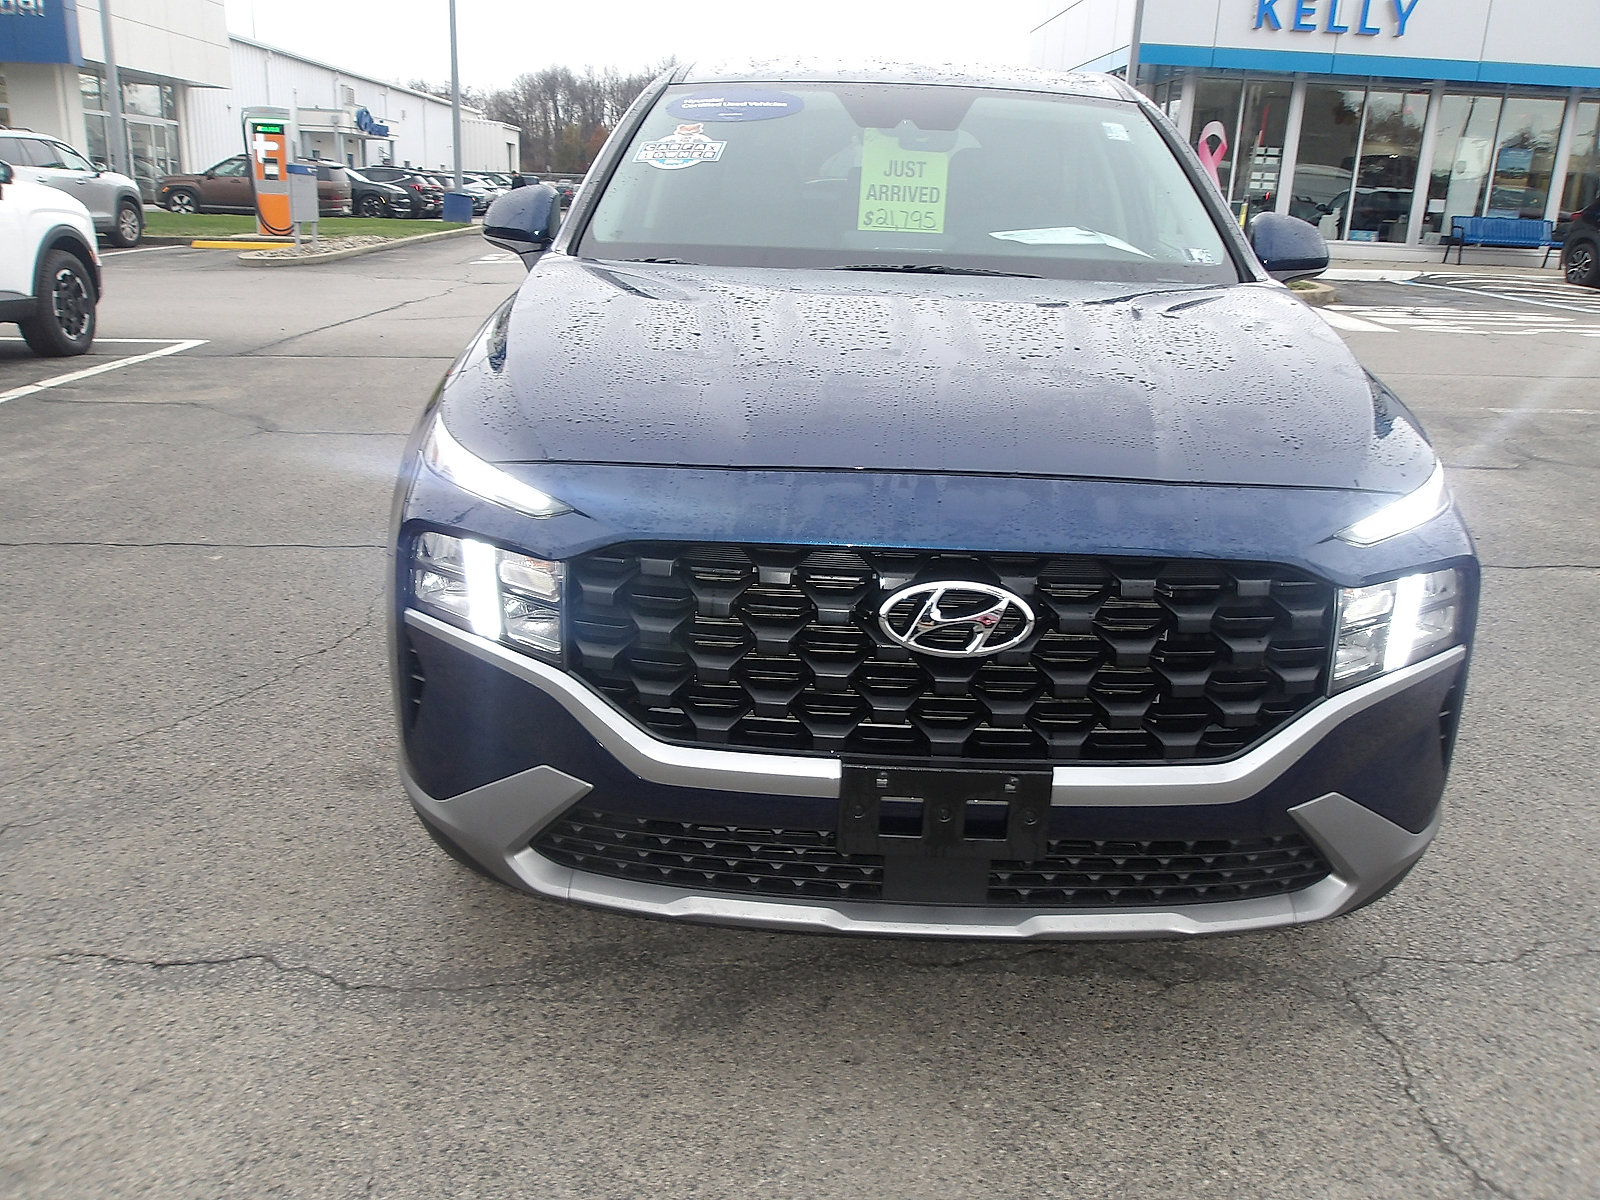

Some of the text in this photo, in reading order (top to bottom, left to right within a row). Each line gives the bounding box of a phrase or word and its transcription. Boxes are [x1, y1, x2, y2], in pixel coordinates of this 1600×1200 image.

[1252, 0, 1419, 37] KELLY
[643, 143, 717, 151] CARFAX
[883, 160, 927, 178] JUST
[865, 184, 940, 204] ARRIVED
[863, 208, 938, 230] $21,795
